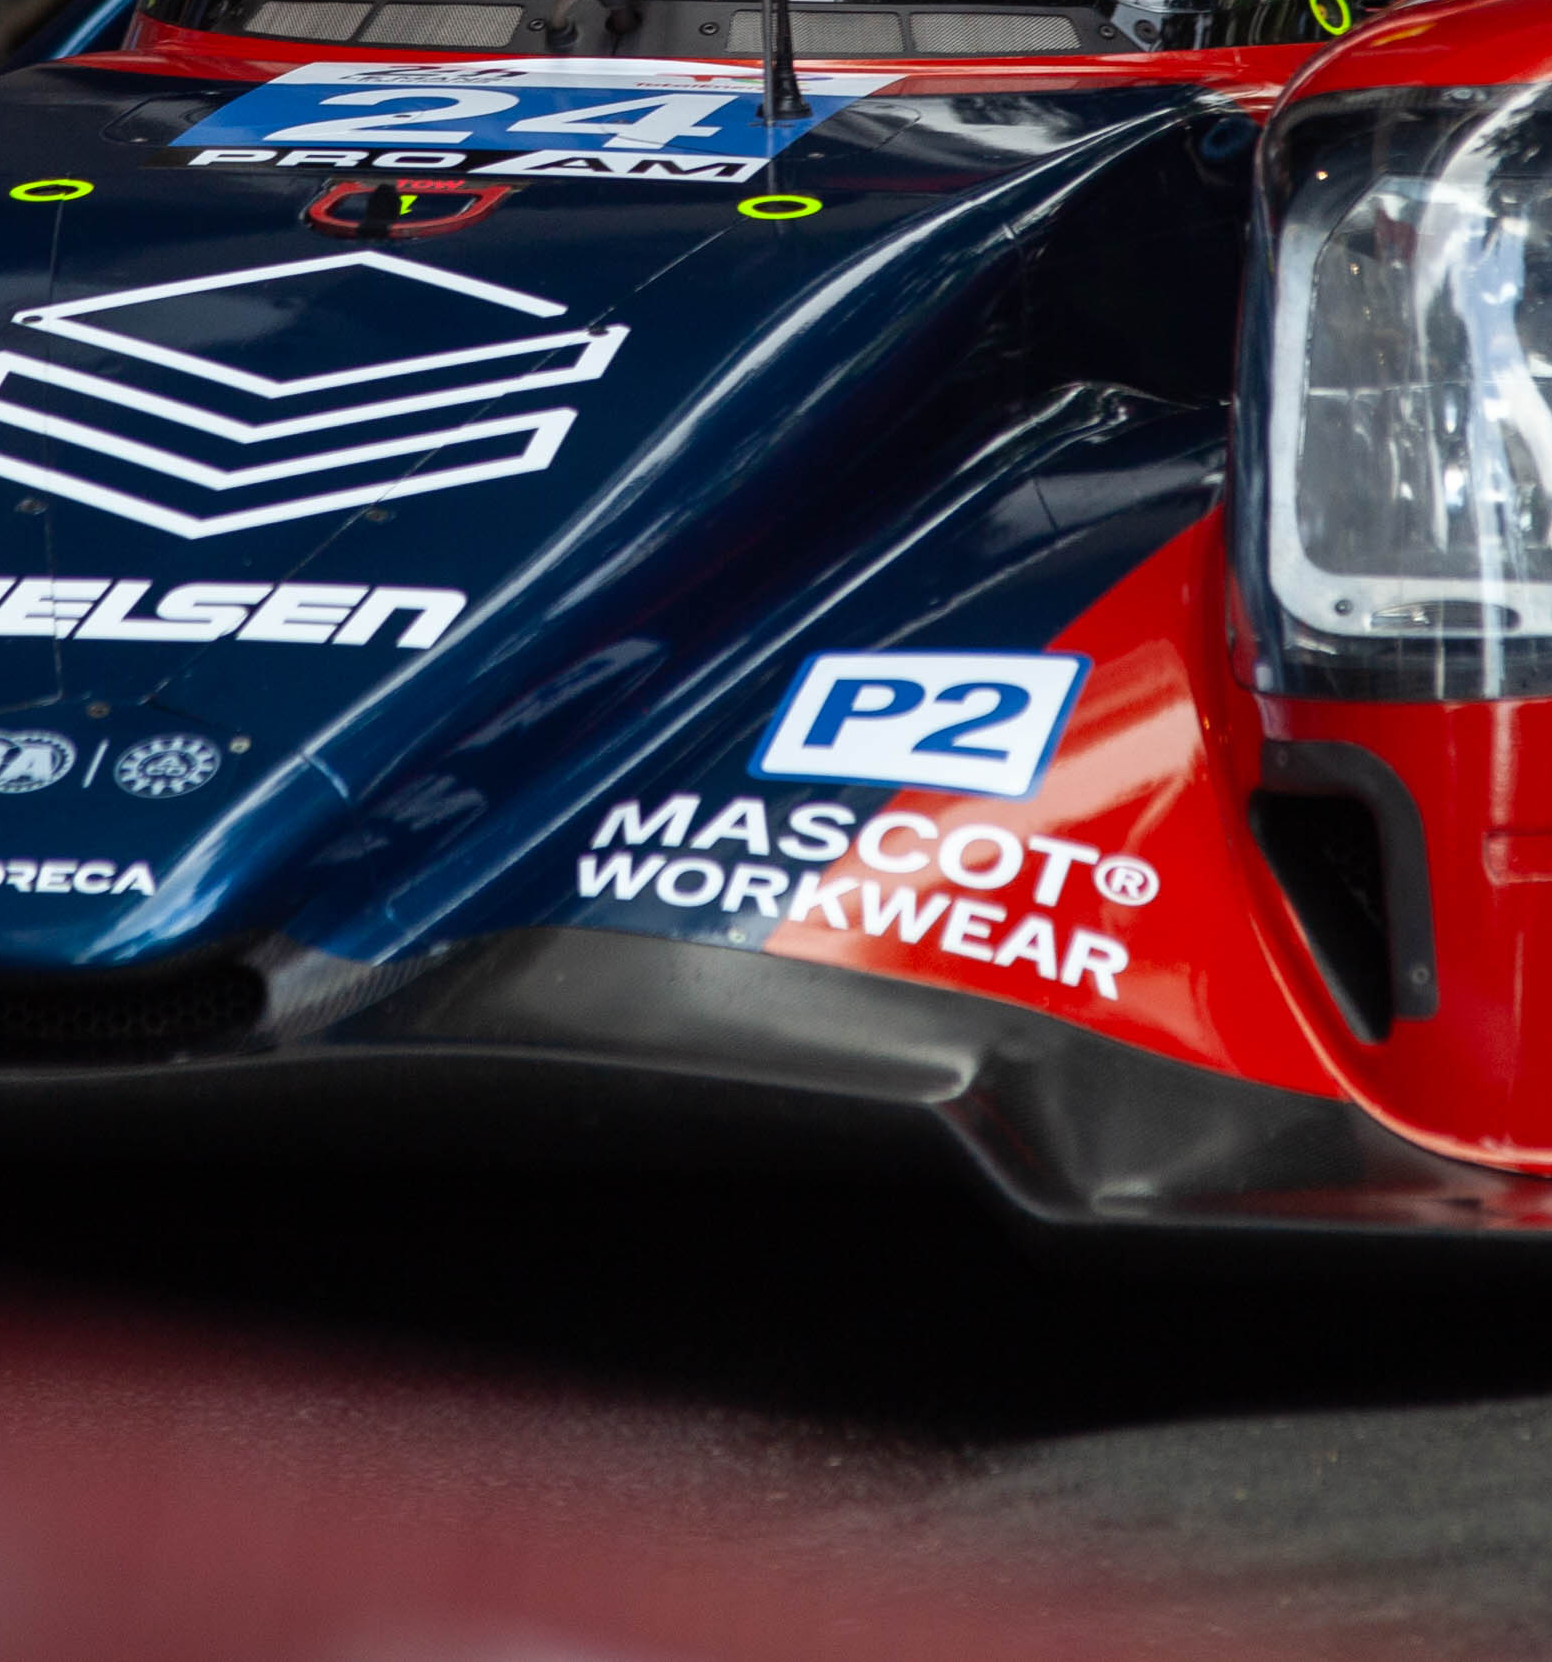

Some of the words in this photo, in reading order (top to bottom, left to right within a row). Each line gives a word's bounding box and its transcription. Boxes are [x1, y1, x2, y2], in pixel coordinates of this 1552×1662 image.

[262, 87, 739, 150] 24
[187, 148, 467, 169] PRO
[522, 156, 749, 178] AM
[801, 677, 1031, 763] P2
[575, 853, 1130, 1002] WORKWEAR
